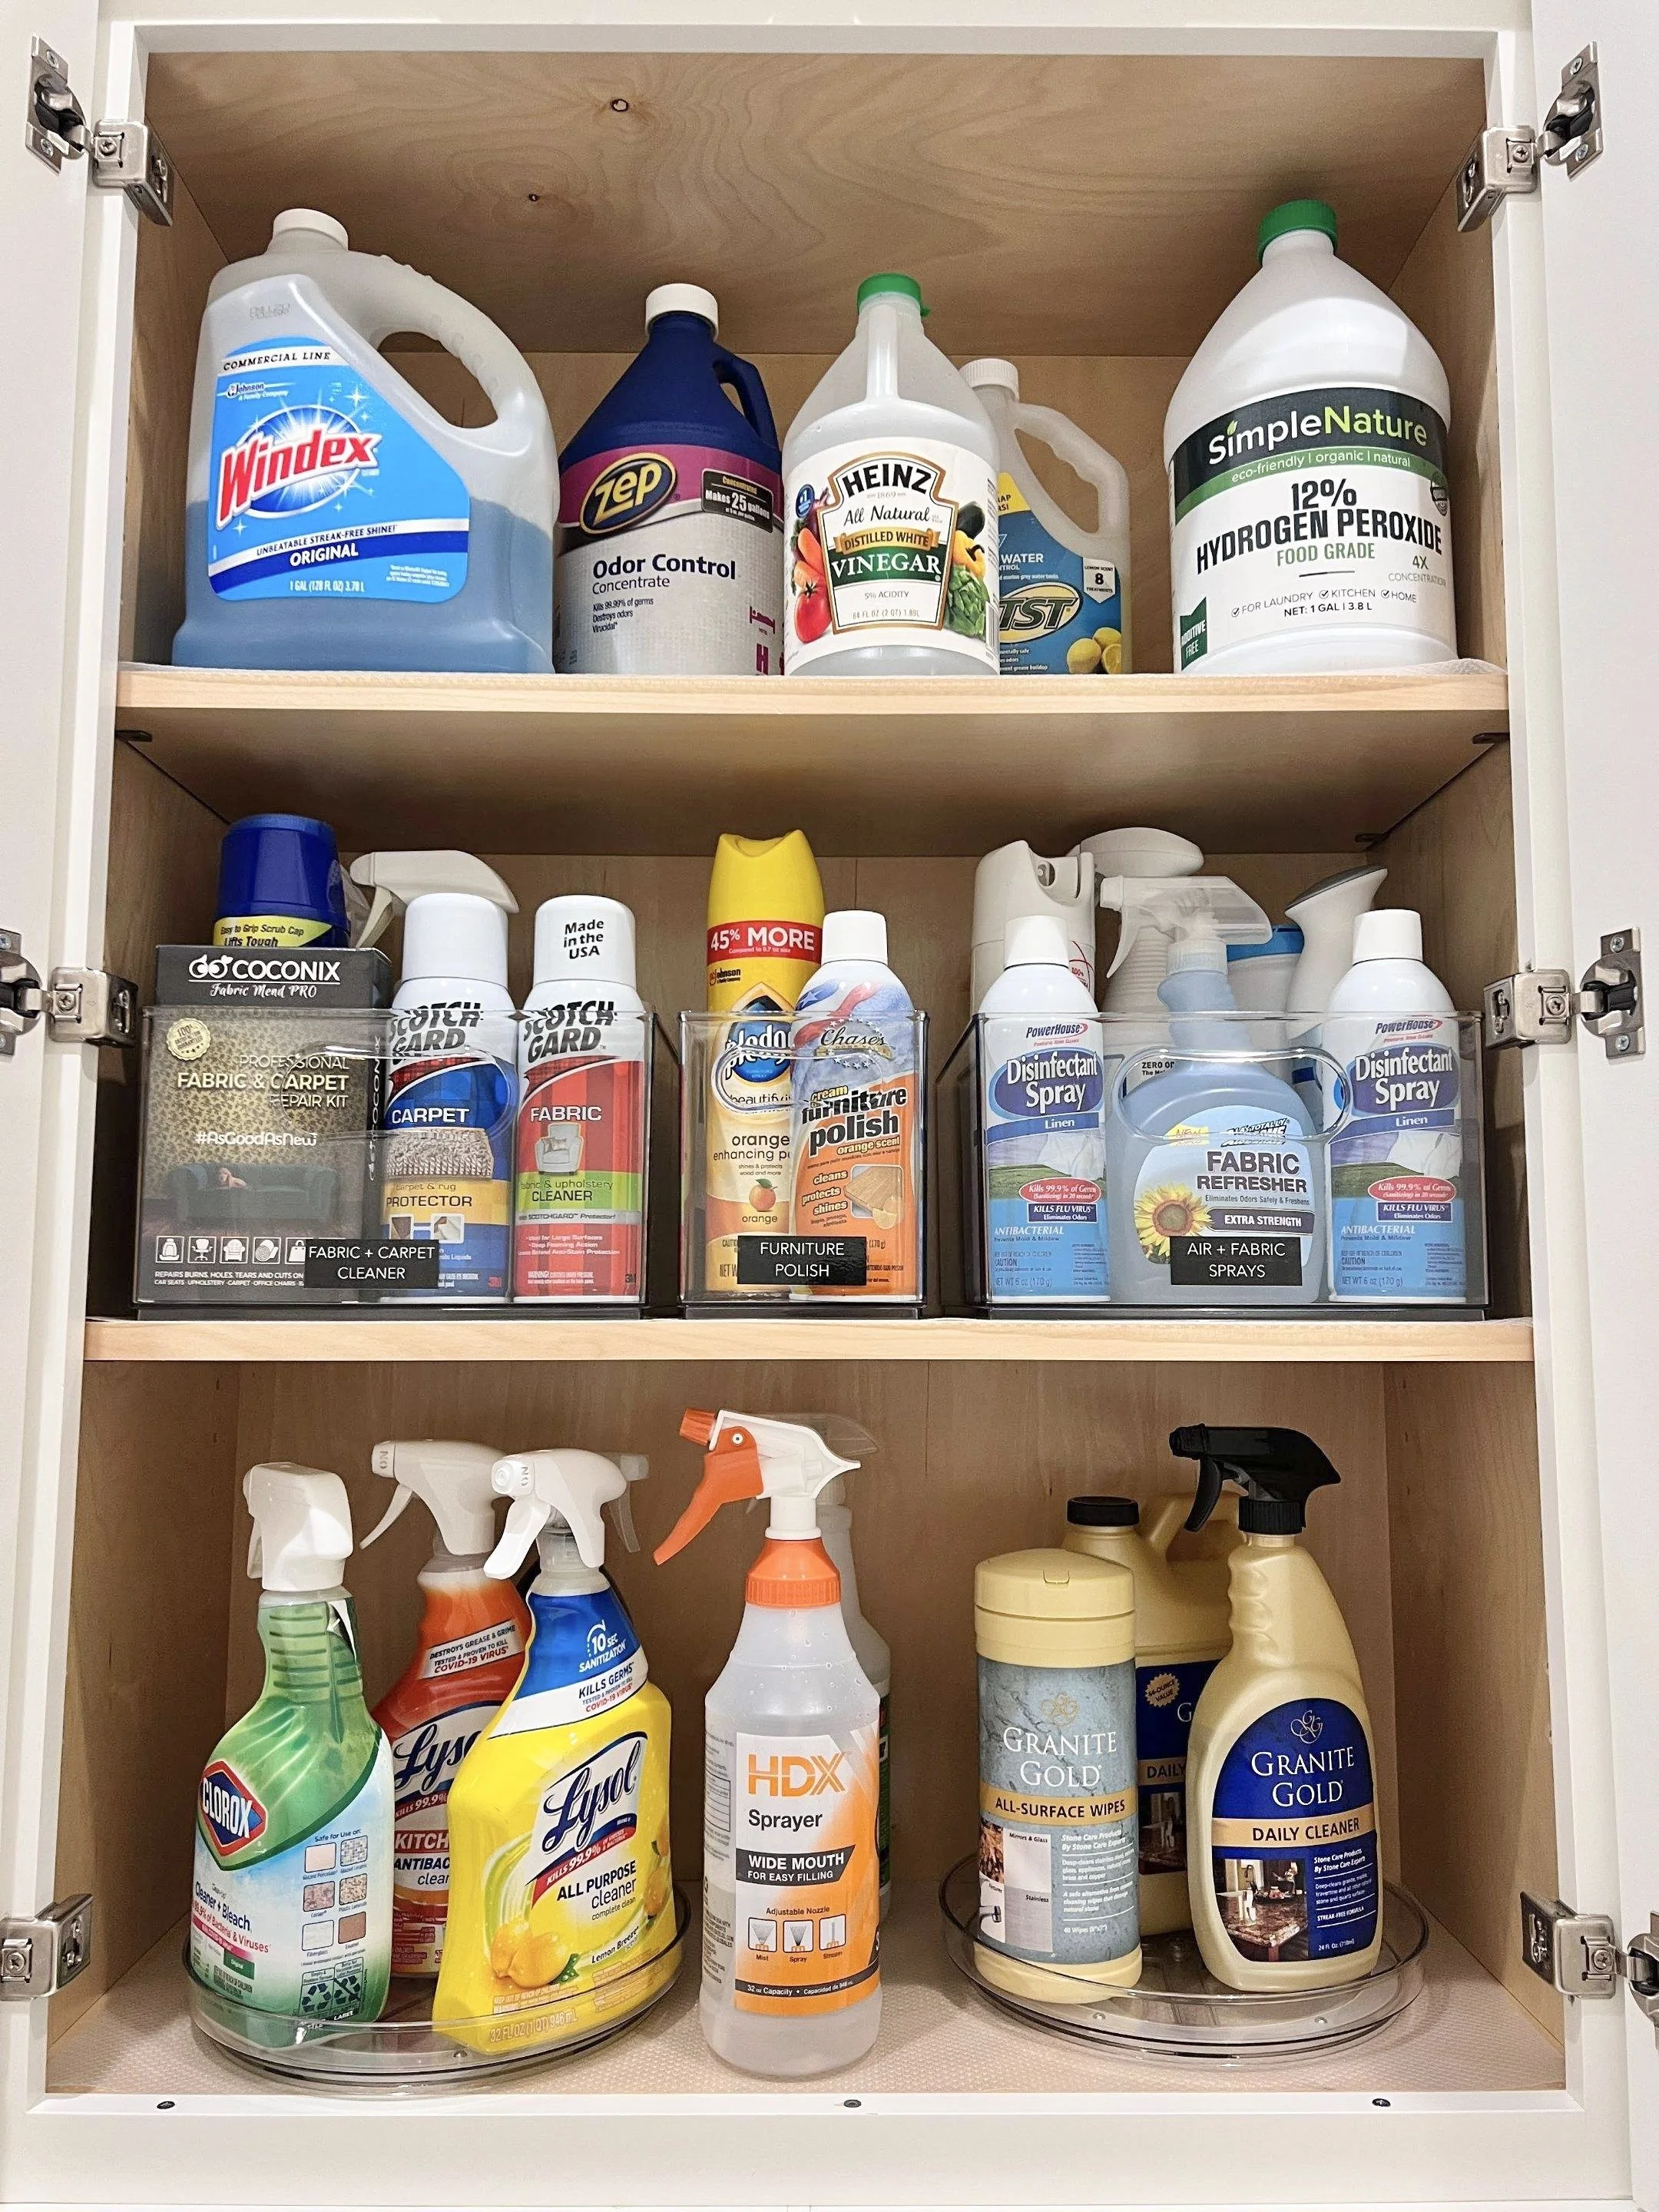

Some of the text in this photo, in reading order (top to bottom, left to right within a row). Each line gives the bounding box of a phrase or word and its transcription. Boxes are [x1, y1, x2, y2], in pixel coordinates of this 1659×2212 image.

[224, 352, 331, 371] COMMERCIAL LINE
[1232, 451, 1410, 482] eco-friendly organic natural
[220, 429, 374, 522] Windex
[842, 464, 932, 498] HEINZ
[705, 490, 747, 512] Makes 25
[1292, 479, 1357, 511] 12%
[844, 505, 930, 525] All Natural
[257, 528, 364, 555] UNBEATABLE STREAK-FREE
[845, 531, 929, 549] DISTILLED WHITE
[1197, 508, 1442, 575] HYDROGEN PEROXIDE
[290, 543, 359, 567] ORIGINAL
[1000, 554, 1043, 563] WATER
[1277, 543, 1376, 566] FOOD GRADE
[1412, 556, 1429, 569] 4X
[593, 554, 736, 580] Odor Control
[831, 553, 941, 578] VINEGAR
[592, 576, 670, 594] Concentrate
[1388, 573, 1446, 587] CONCENTRATION
[635, 598, 653, 606] germs
[1243, 588, 1417, 614] FOR LAUNDRY KITCHEN HOME
[1284, 607, 1306, 617] NET:
[1318, 603, 1339, 611] GAL
[260, 925, 304, 936] Scrub Cap
[565, 920, 604, 935] Made
[564, 933, 604, 948] in the
[710, 928, 815, 952] 45% MORE
[569, 946, 600, 959] USA
[232, 960, 340, 982] COCONIX
[210, 983, 317, 998] Fabric Mend PRO
[1026, 1023, 1083, 1038] PowerHouse
[1375, 1021, 1435, 1035] PowerHouse
[528, 1027, 600, 1063] GARD
[1006, 1051, 1098, 1085] Disinfectant
[1355, 1048, 1452, 1081] Disinfectant
[177, 1073, 349, 1091] FABRIC CARPET
[326, 1095, 349, 1108] KIT
[810, 1086, 848, 1101] cream
[1025, 1081, 1086, 1114] Spray
[1375, 1078, 1439, 1112] Spray
[531, 1107, 602, 1121] FABRIC
[801, 1087, 906, 1124] furniture
[392, 1108, 469, 1124] CARPET
[1045, 1118, 1075, 1129] Linen
[1396, 1116, 1428, 1128] Linen
[732, 1135, 790, 1148] orange
[809, 1110, 899, 1158] polish
[837, 1137, 900, 1154] orange scent
[714, 1150, 774, 1161] enhancing
[1207, 1151, 1299, 1174] FABRIC
[555, 1180, 613, 1190] upholstery
[813, 1171, 848, 1185] cleans
[1197, 1176, 1306, 1193] REFRESHER
[802, 1186, 841, 1206] protects
[1045, 1184, 1069, 1193] 99.9%
[1396, 1183, 1422, 1192] 99.9%
[387, 1196, 472, 1207] PROTECTOR
[532, 1191, 592, 1202] CLEANER
[1205, 1194, 1237, 1203] Eliminates
[813, 1201, 848, 1215] shines
[742, 1215, 777, 1224] orange
[1225, 1215, 1302, 1227] EXTRA STRENGTH
[995, 1227, 1064, 1235] ANTIBACTERIAL
[1342, 1225, 1415, 1234] ANTIBACTERIAL
[309, 1247, 435, 1259] FABRIC CARPET
[760, 1243, 845, 1256] FURNITURE
[1187, 1243, 1285, 1255] AIR FABRIC
[338, 1267, 406, 1279] CLEANER
[775, 1264, 830, 1277] POLISH
[1209, 1264, 1265, 1277] SPRAYS
[430, 1624, 515, 1660] DESTROYS GREASE GRIME
[592, 1634, 606, 1654] 10
[435, 1646, 487, 1666] TESTED PROVEN
[579, 1641, 626, 1673] SANITIZATION
[435, 1657, 478, 1673] COVID-19
[579, 1679, 606, 1699] KILLS
[1155, 1690, 1174, 1701] VALUE
[586, 1694, 616, 1712] COVID-19
[1003, 1727, 1117, 1756] GRANITE
[1251, 1747, 1355, 1777] GRANITE
[748, 1752, 846, 1797] HDX
[1020, 1761, 1100, 1787] GOLD
[1147, 1763, 1186, 1779] DAILY
[415, 1793, 447, 1810] 99.9%
[542, 1740, 640, 1853] Lysol
[1272, 1780, 1343, 1807] GOLD
[203, 1777, 253, 1839] CLOROX
[995, 1797, 1125, 1818] ALL-SURFACE WIPES
[749, 1809, 823, 1832] Sprayer
[1253, 1817, 1359, 1841] DAILY CLEANER
[547, 1845, 601, 1886] KILLS 99.9%
[748, 1852, 844, 1869] WIDE MOUTH
[557, 1860, 637, 1901] ALL PURPOSE
[748, 1870, 833, 1882] FOR EASY FILLING
[591, 1879, 637, 1909] cleaner
[195, 1881, 251, 1932] Cleaner Bleach
[592, 1906, 621, 1921] complete
[766, 1907, 804, 1916] Adjustable
[239, 1935, 270, 1953] Viruses
[592, 1948, 615, 1963] Lemon
[763, 1986, 831, 1996] Capacity Capacidad
